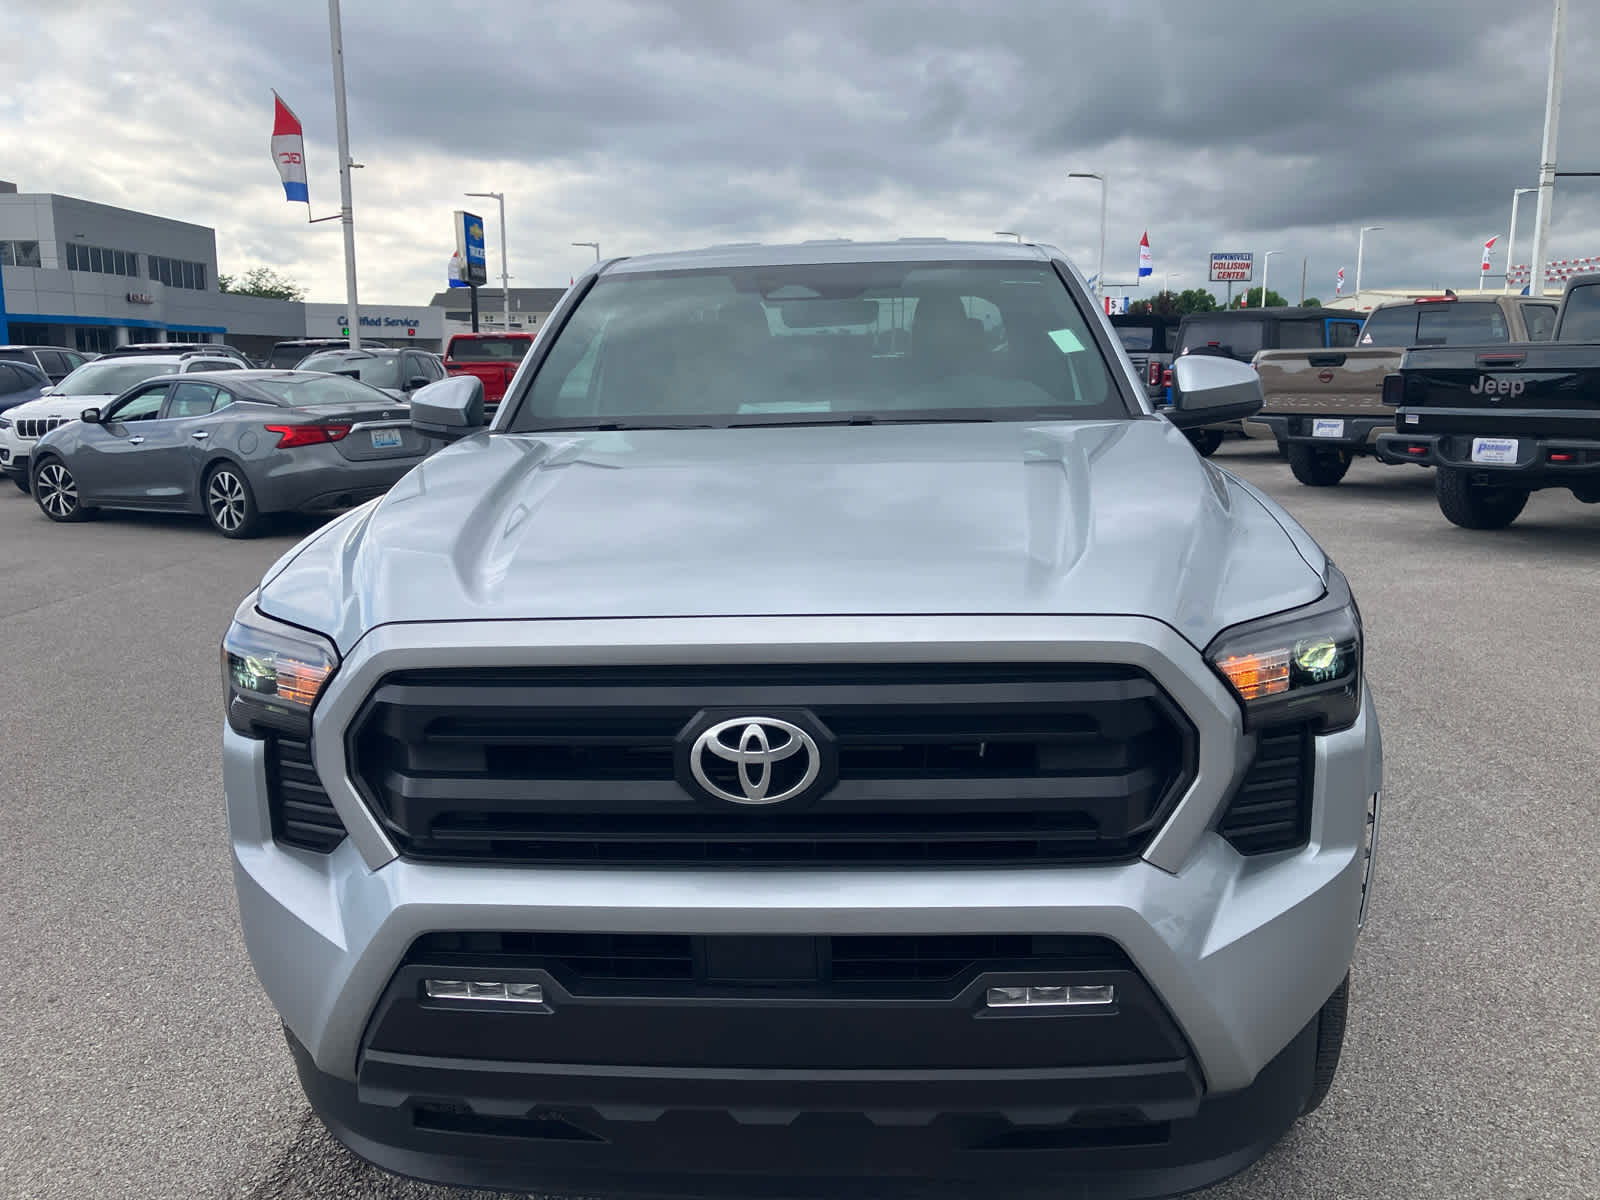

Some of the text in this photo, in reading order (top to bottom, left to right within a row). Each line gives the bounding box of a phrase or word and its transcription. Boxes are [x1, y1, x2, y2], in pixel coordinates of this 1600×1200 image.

[1213, 262, 1251, 270] COLLISION
[1217, 271, 1246, 280] CENTER
[383, 316, 419, 327] Service
[1470, 375, 1525, 398] Jeep
